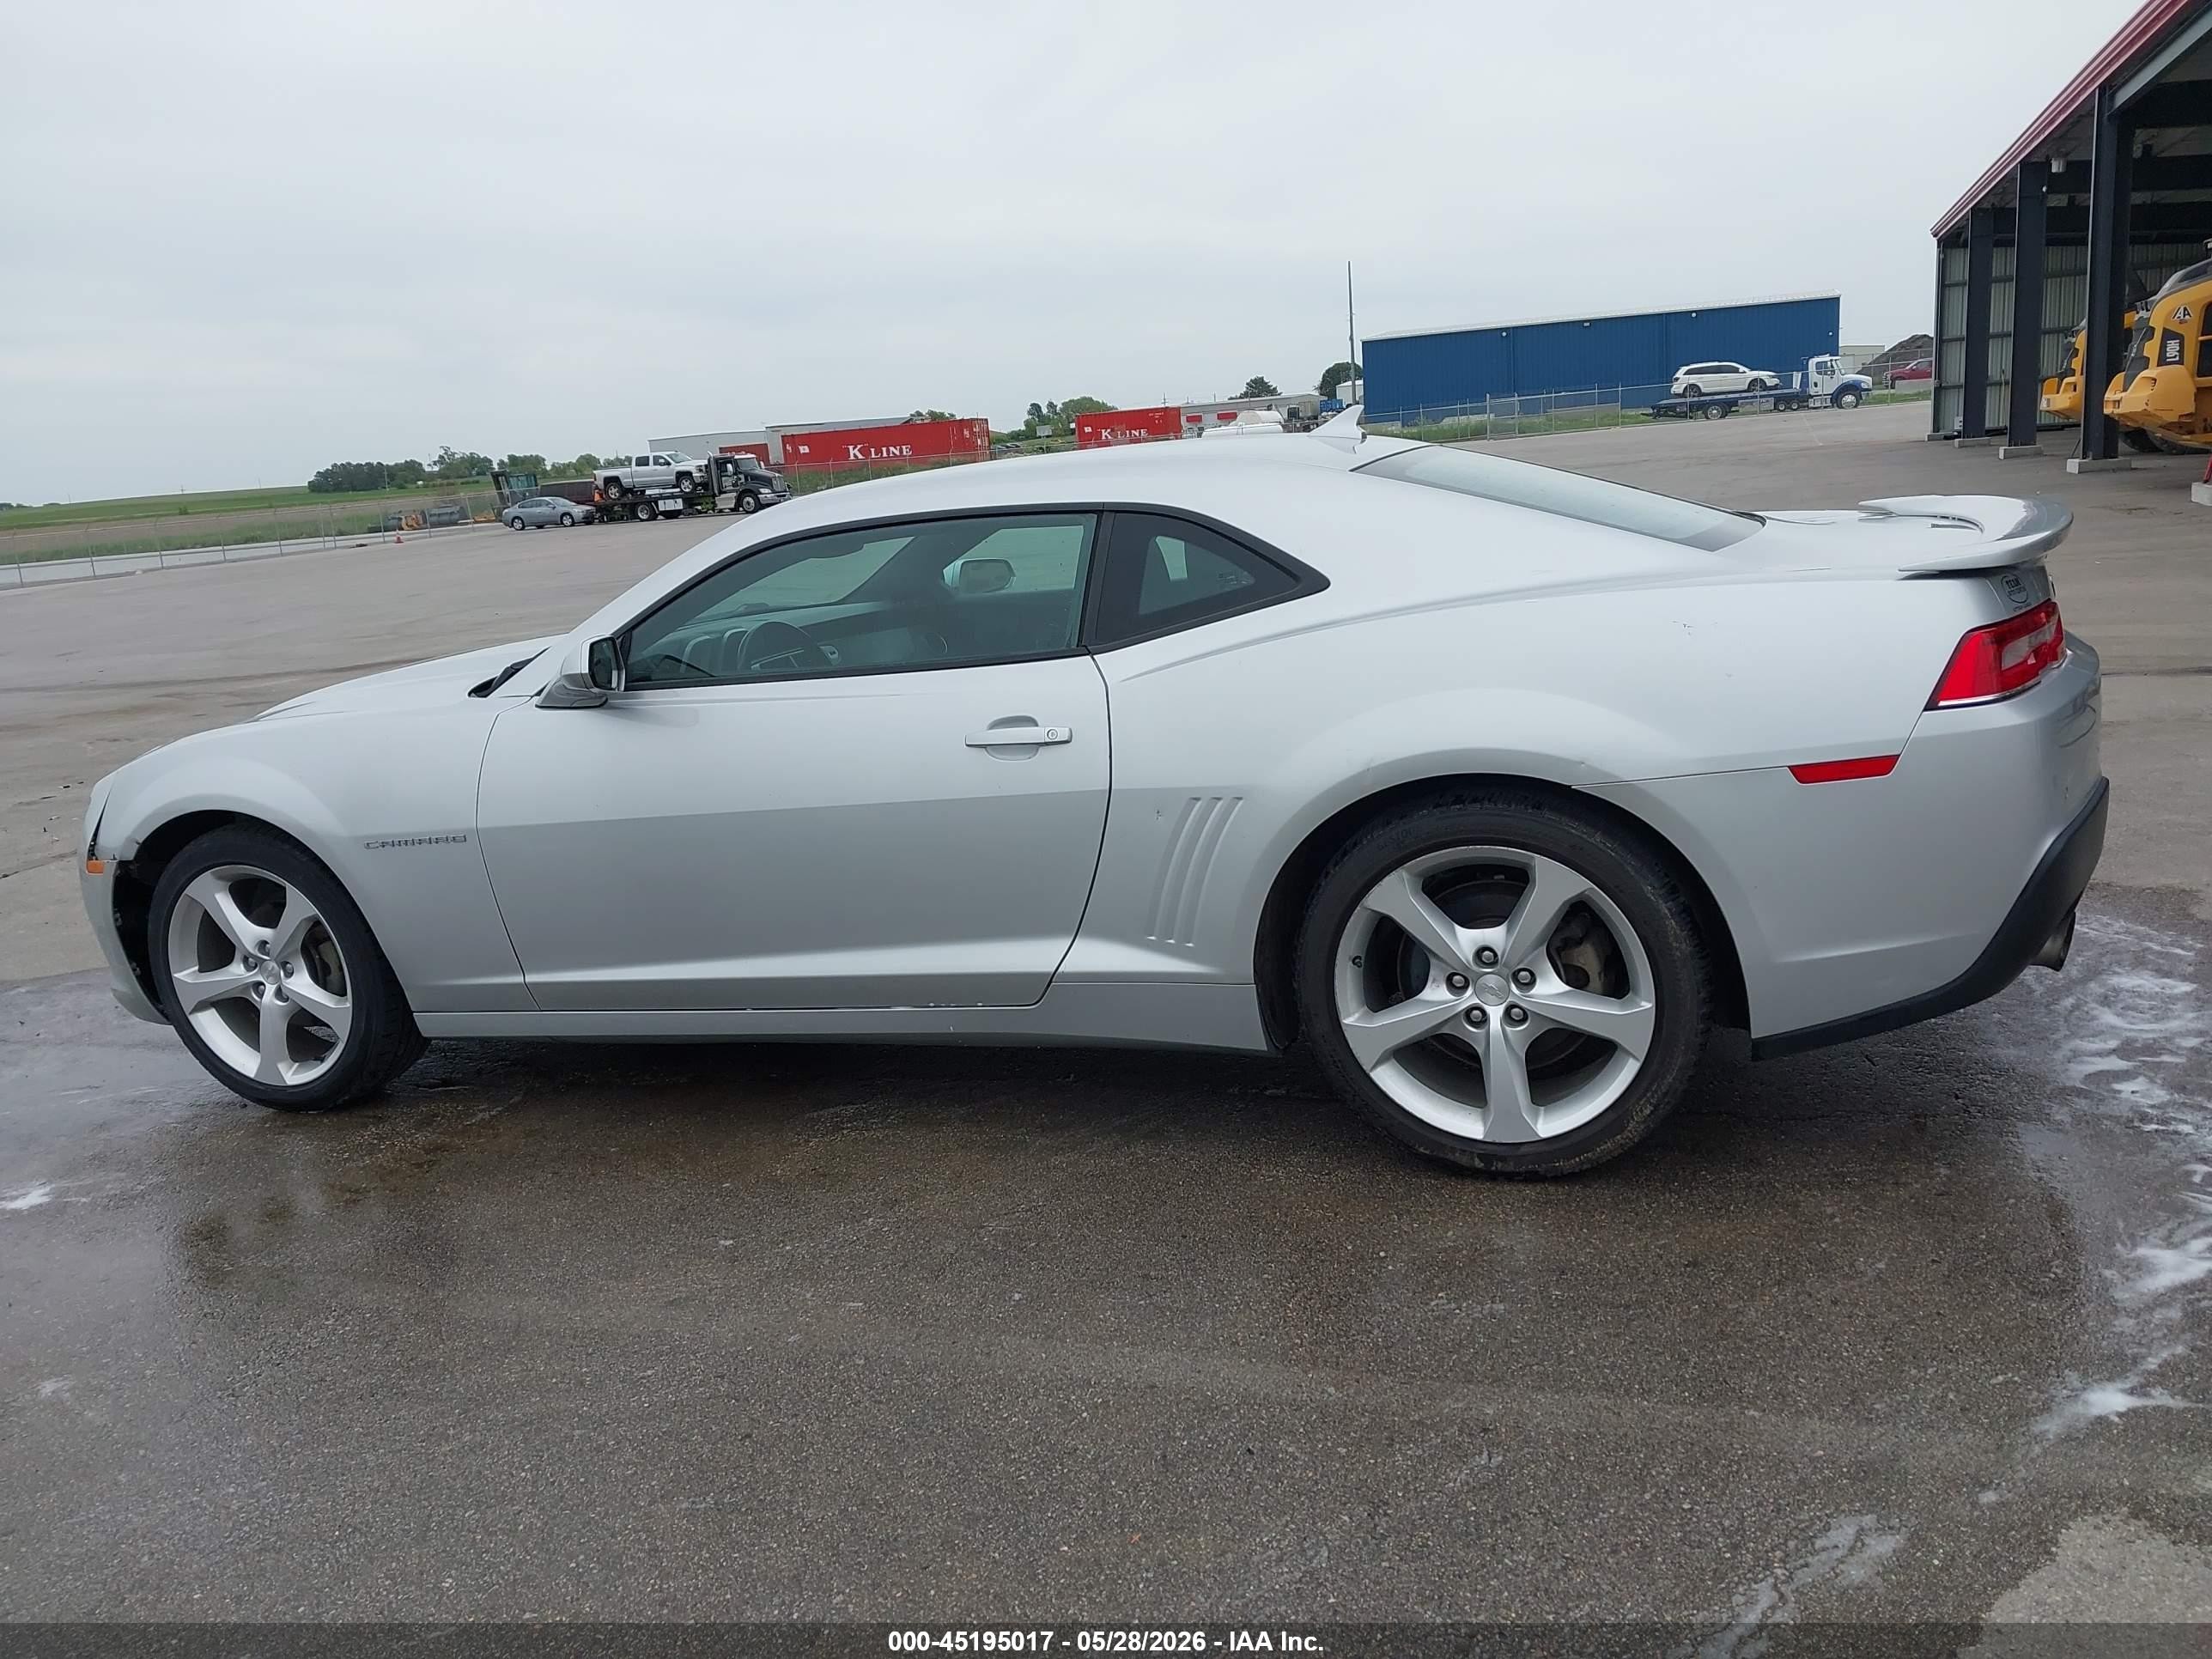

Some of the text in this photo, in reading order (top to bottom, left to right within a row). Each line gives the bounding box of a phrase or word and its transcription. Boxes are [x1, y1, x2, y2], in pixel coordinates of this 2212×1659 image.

[2166, 339, 2180, 362] L90H
[1116, 428, 1149, 439] LINE
[869, 445, 913, 459] LINE
[363, 834, 467, 850] CAMARO
